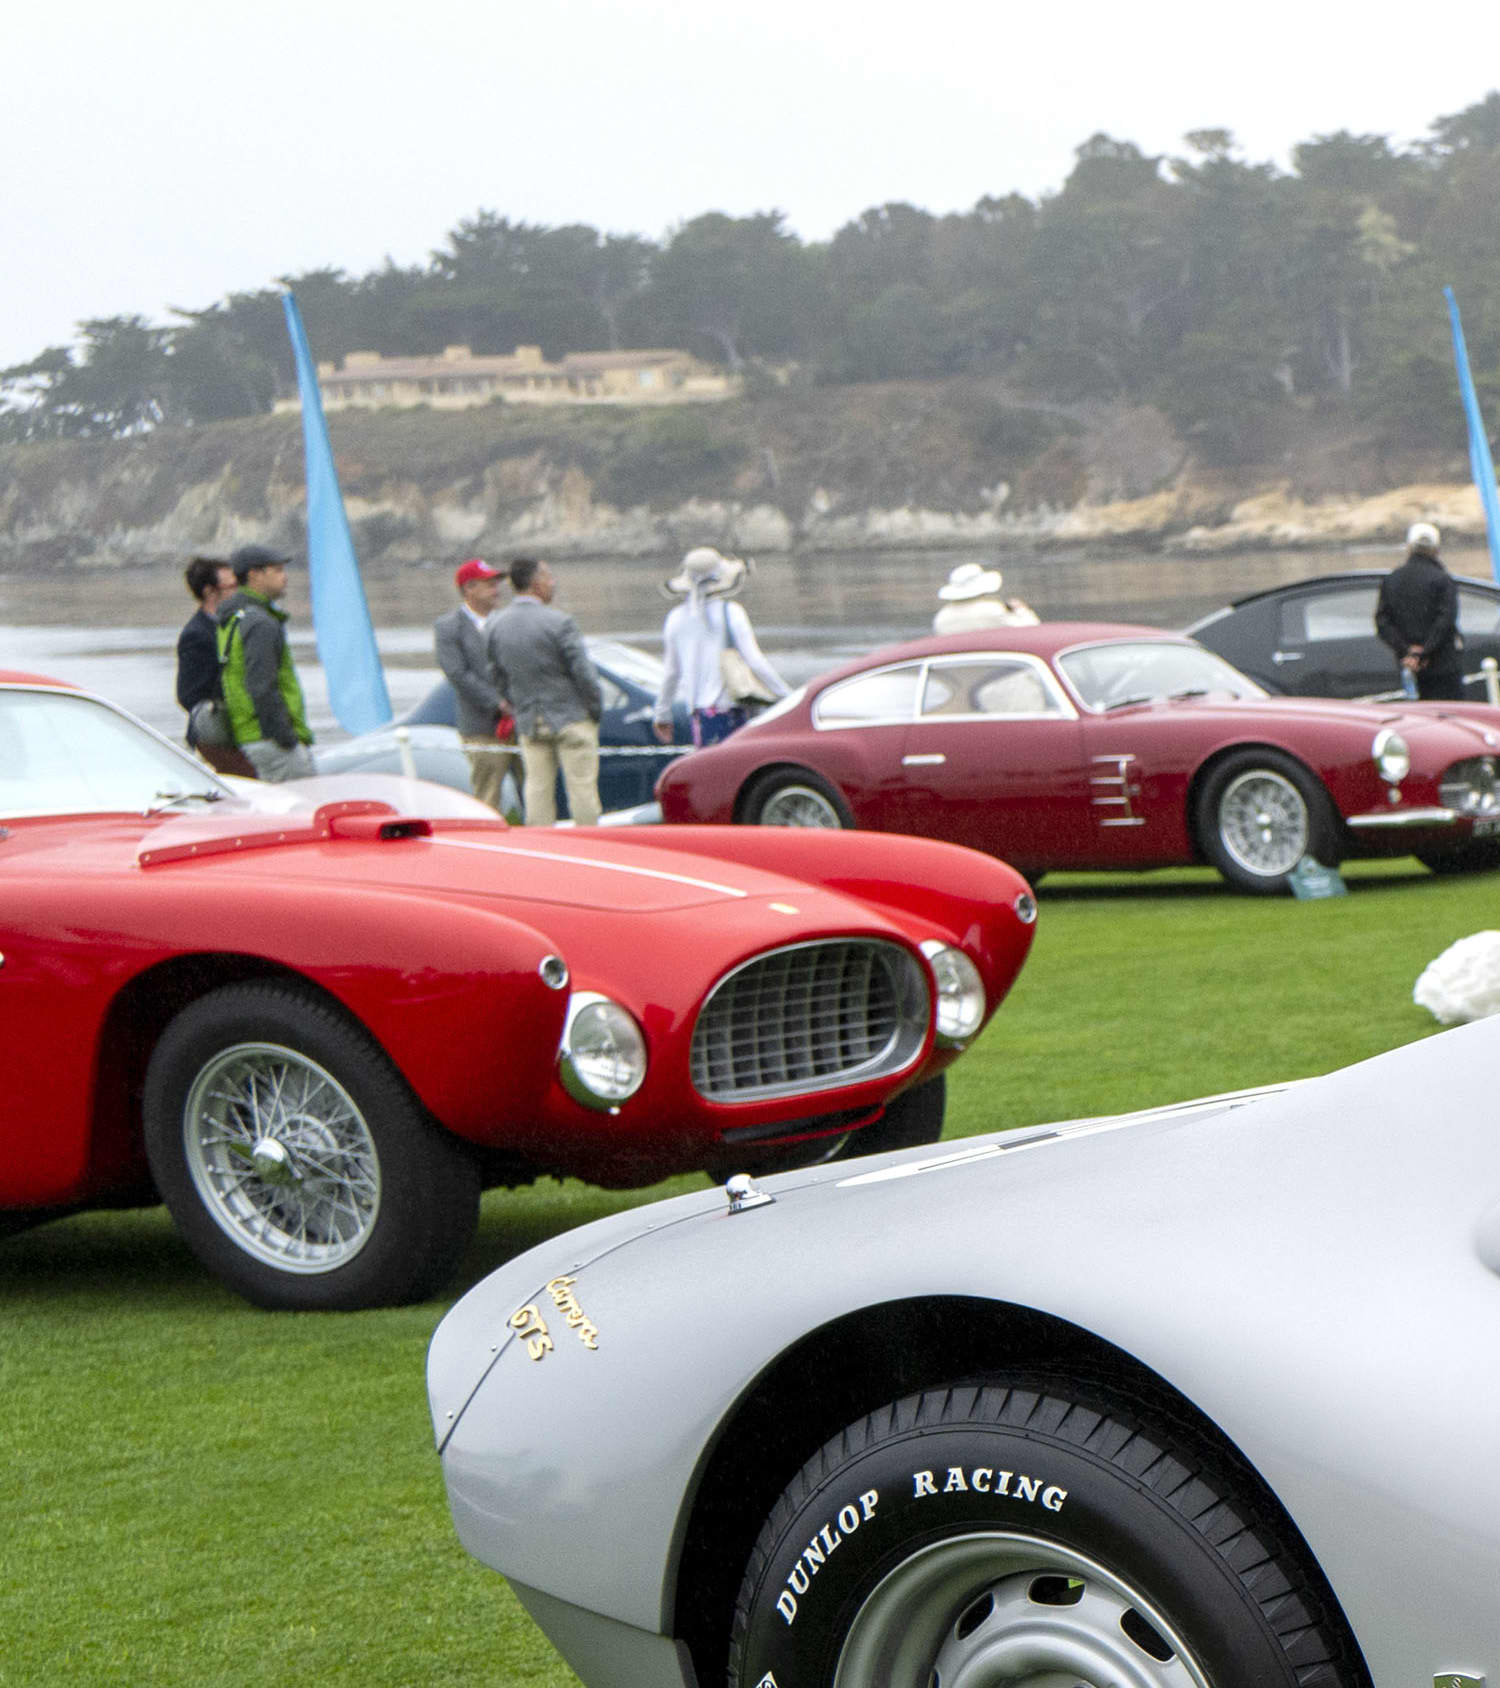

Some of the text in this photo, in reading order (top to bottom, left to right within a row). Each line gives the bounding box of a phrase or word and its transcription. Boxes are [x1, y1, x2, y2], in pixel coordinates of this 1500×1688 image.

[510, 1304, 554, 1361] GTS
[546, 1275, 599, 1350] Carrera
[776, 1467, 1068, 1625] DUNLOP RACING
